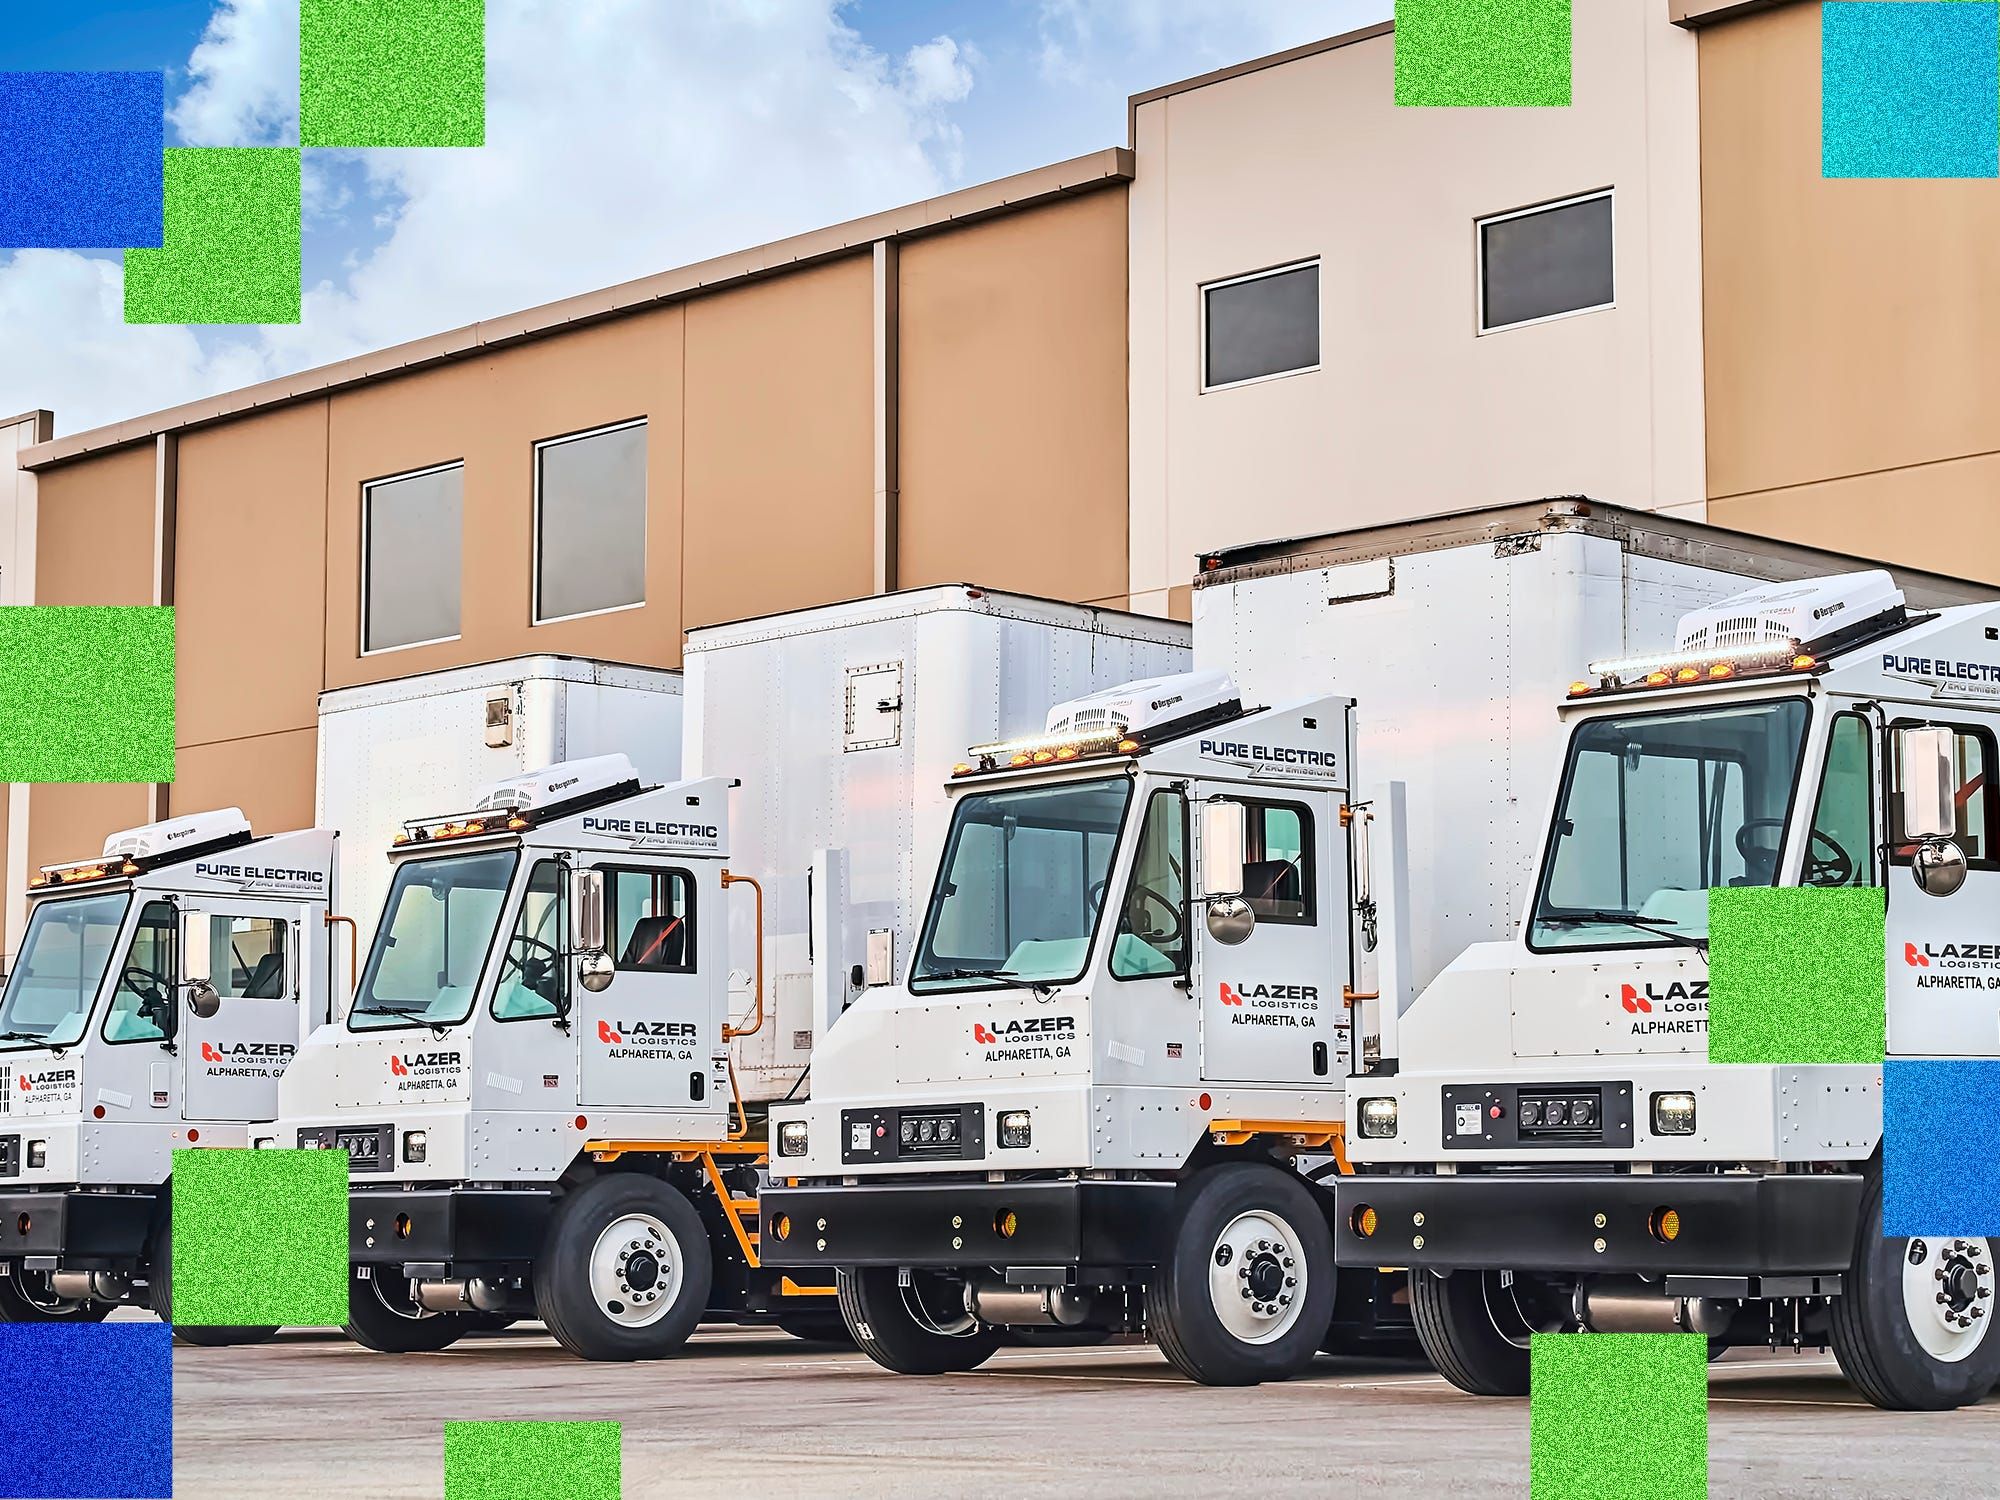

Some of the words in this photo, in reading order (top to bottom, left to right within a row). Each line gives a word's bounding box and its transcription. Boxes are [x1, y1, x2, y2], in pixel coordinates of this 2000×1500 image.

[1820, 601, 1845, 616] Bergstrom
[1883, 654, 1931, 675] PURE
[1935, 660, 2000, 682] ELECTR
[1158, 695, 1183, 708] Bergstrom
[1200, 740, 1248, 758] PURE
[1252, 745, 1336, 767] ELECTRIC
[583, 818, 630, 832] PURE
[634, 821, 718, 838] ELECTRIC
[195, 863, 241, 877] PURE
[244, 867, 323, 883] ELECTRIC
[1940, 961, 2000, 969] LOGISTIC
[1917, 975, 1985, 991] ALPHARETTA,
[1238, 983, 1318, 1000] LAZER
[1646, 981, 1709, 1000] LAZ
[1252, 1001, 1319, 1010] LOGISTICS
[991, 1016, 1075, 1034] LAZER
[1231, 1013, 1299, 1028] ALPHARETTA,
[1301, 1016, 1316, 1027] GA
[1631, 1020, 1709, 1035] ALPHARETT
[617, 1021, 697, 1036] LAZER
[631, 1038, 697, 1046] LOGISTICS
[1005, 1033, 1076, 1043] LOGISTICS
[218, 1042, 296, 1056] LAZER
[608, 1048, 676, 1060] ALPHARETTA,
[678, 1050, 693, 1060] GA
[985, 1048, 1053, 1062] ALPHARETTA,
[1056, 1046, 1071, 1058] GA
[404, 1052, 461, 1066] LAZER
[29, 1070, 75, 1083] LAZER
[207, 1068, 270, 1078] ALPHARETTA,
[414, 1067, 462, 1075] LOGISTICS
[36, 1082, 76, 1091] LOGISTICS
[398, 1080, 445, 1091] ALPHARETTA,
[446, 1078, 458, 1089] GA
